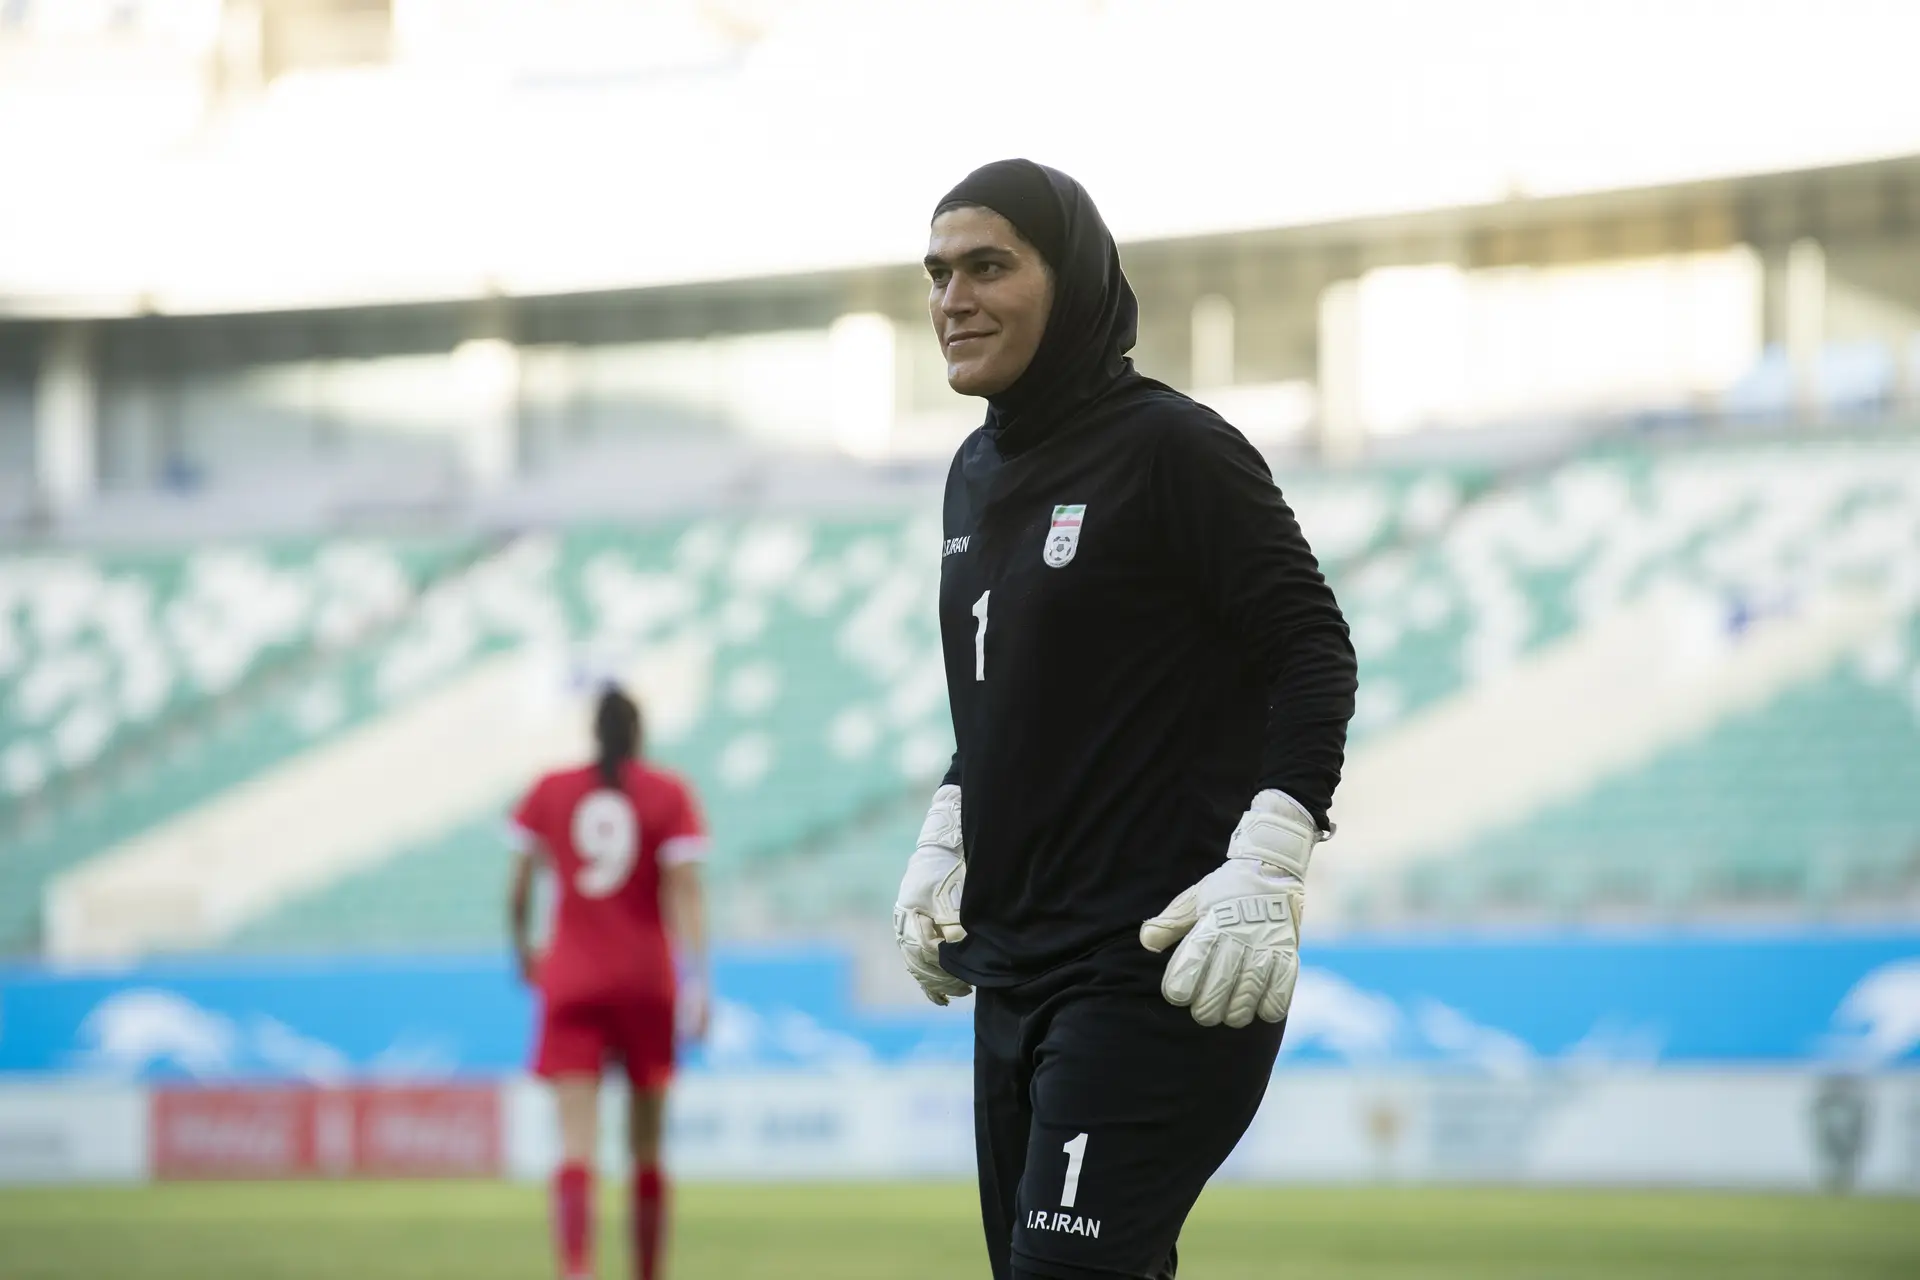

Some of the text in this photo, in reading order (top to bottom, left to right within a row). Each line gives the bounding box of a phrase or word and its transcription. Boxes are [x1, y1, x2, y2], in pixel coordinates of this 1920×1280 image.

[972, 590, 991, 681] 1
[571, 789, 640, 898] 9
[1061, 1132, 1089, 1208] 1
[1027, 1210, 1101, 1239] I.R.IRAN
